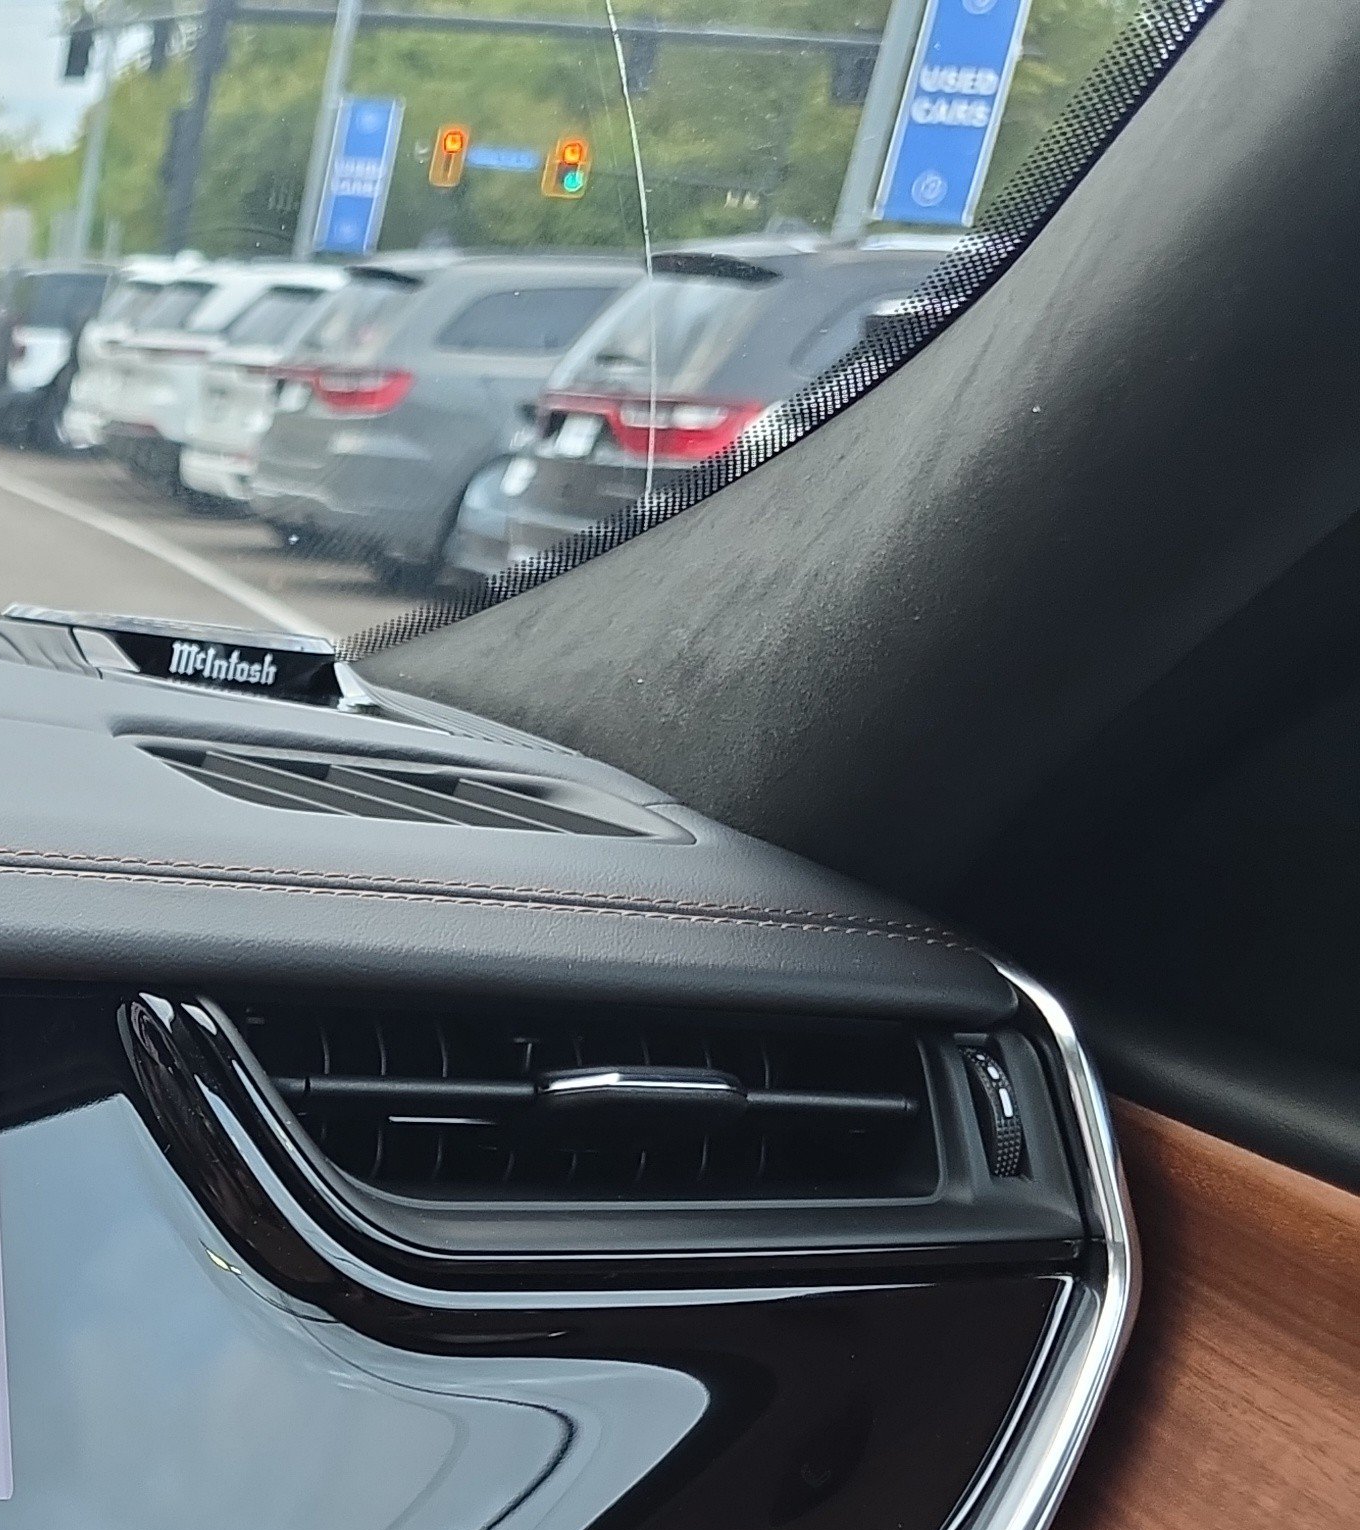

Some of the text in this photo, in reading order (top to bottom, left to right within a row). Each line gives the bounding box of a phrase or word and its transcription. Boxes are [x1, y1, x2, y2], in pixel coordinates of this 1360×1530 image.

[919, 64, 999, 95] USED
[911, 96, 992, 128] CARS
[169, 640, 278, 685] McIntosh
